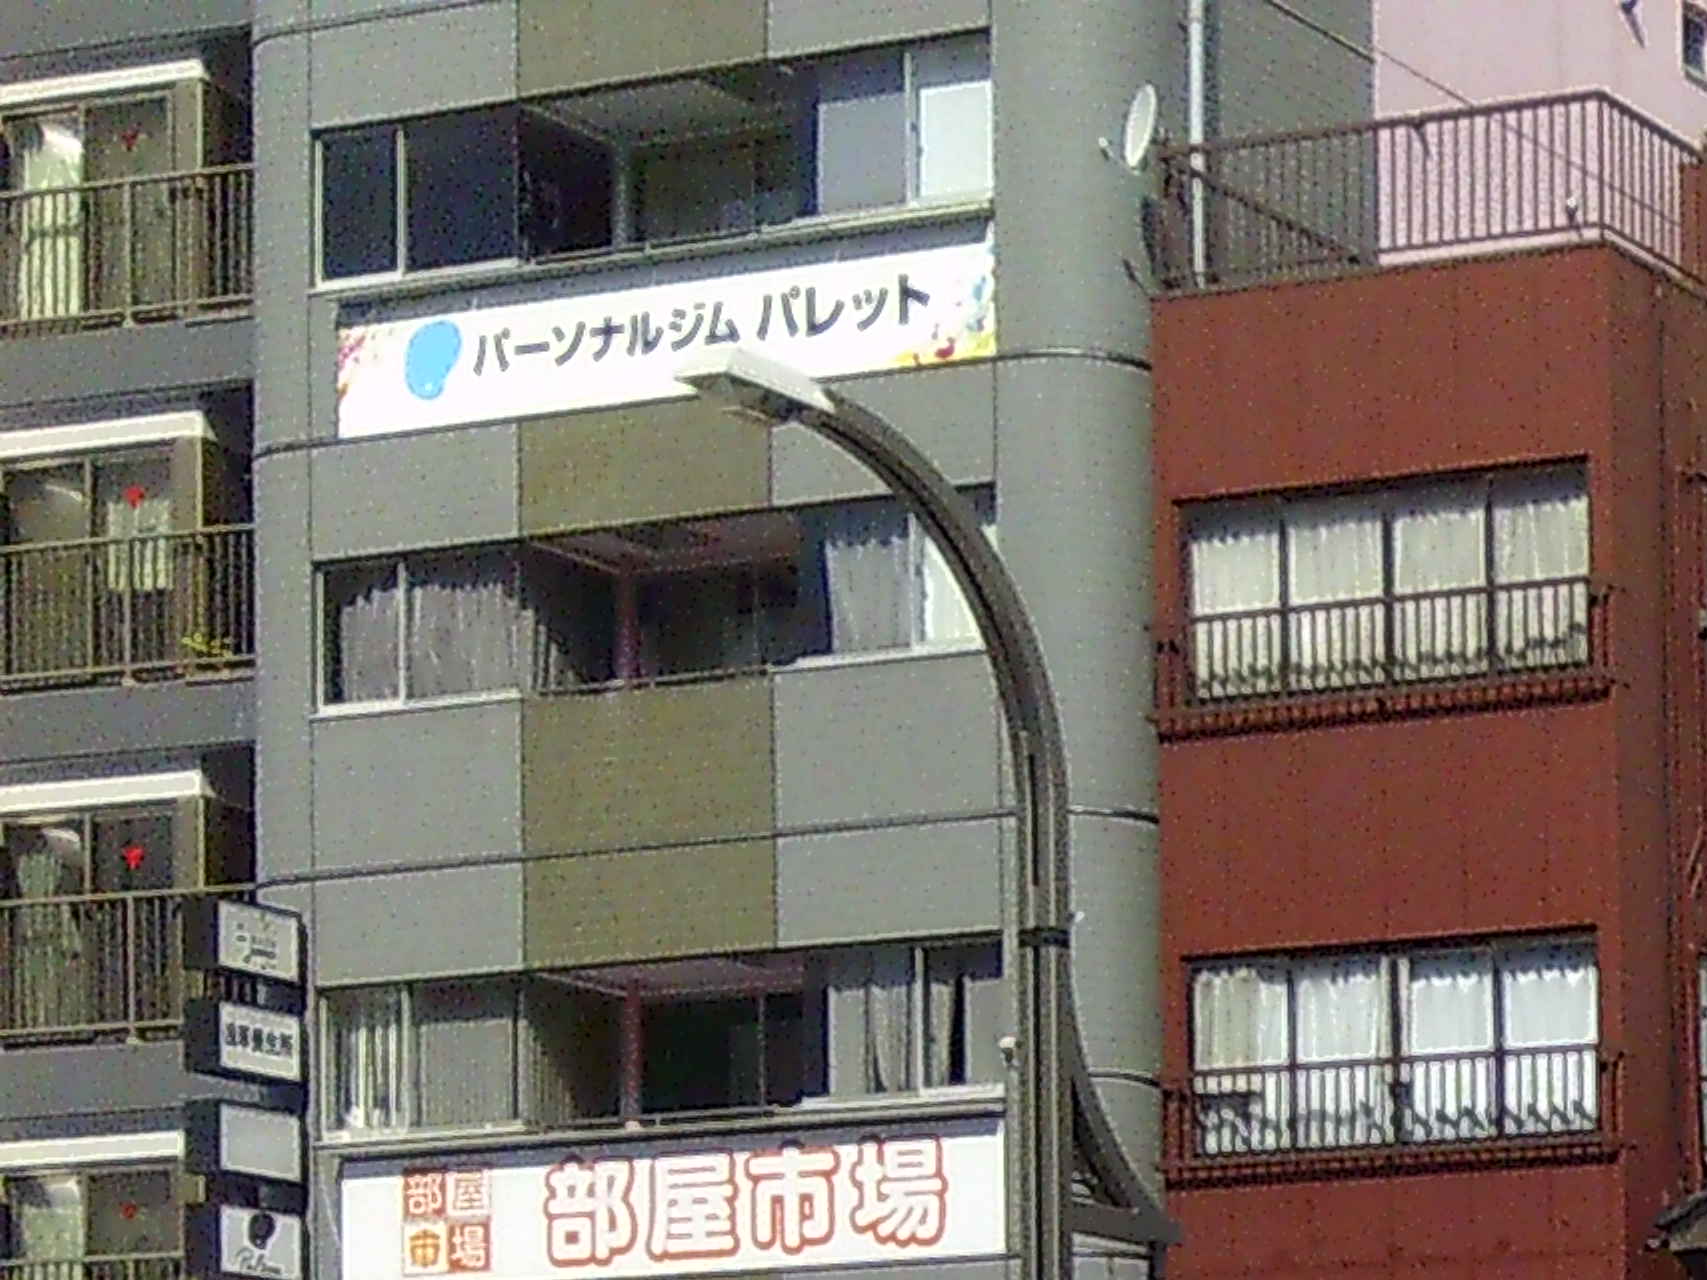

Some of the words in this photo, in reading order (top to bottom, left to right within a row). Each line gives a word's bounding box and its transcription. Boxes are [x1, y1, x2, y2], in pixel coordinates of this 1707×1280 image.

[472, 300, 741, 377] パーソナルジム
[756, 273, 931, 343] パレット
[542, 1132, 946, 1268] 部屋市場
